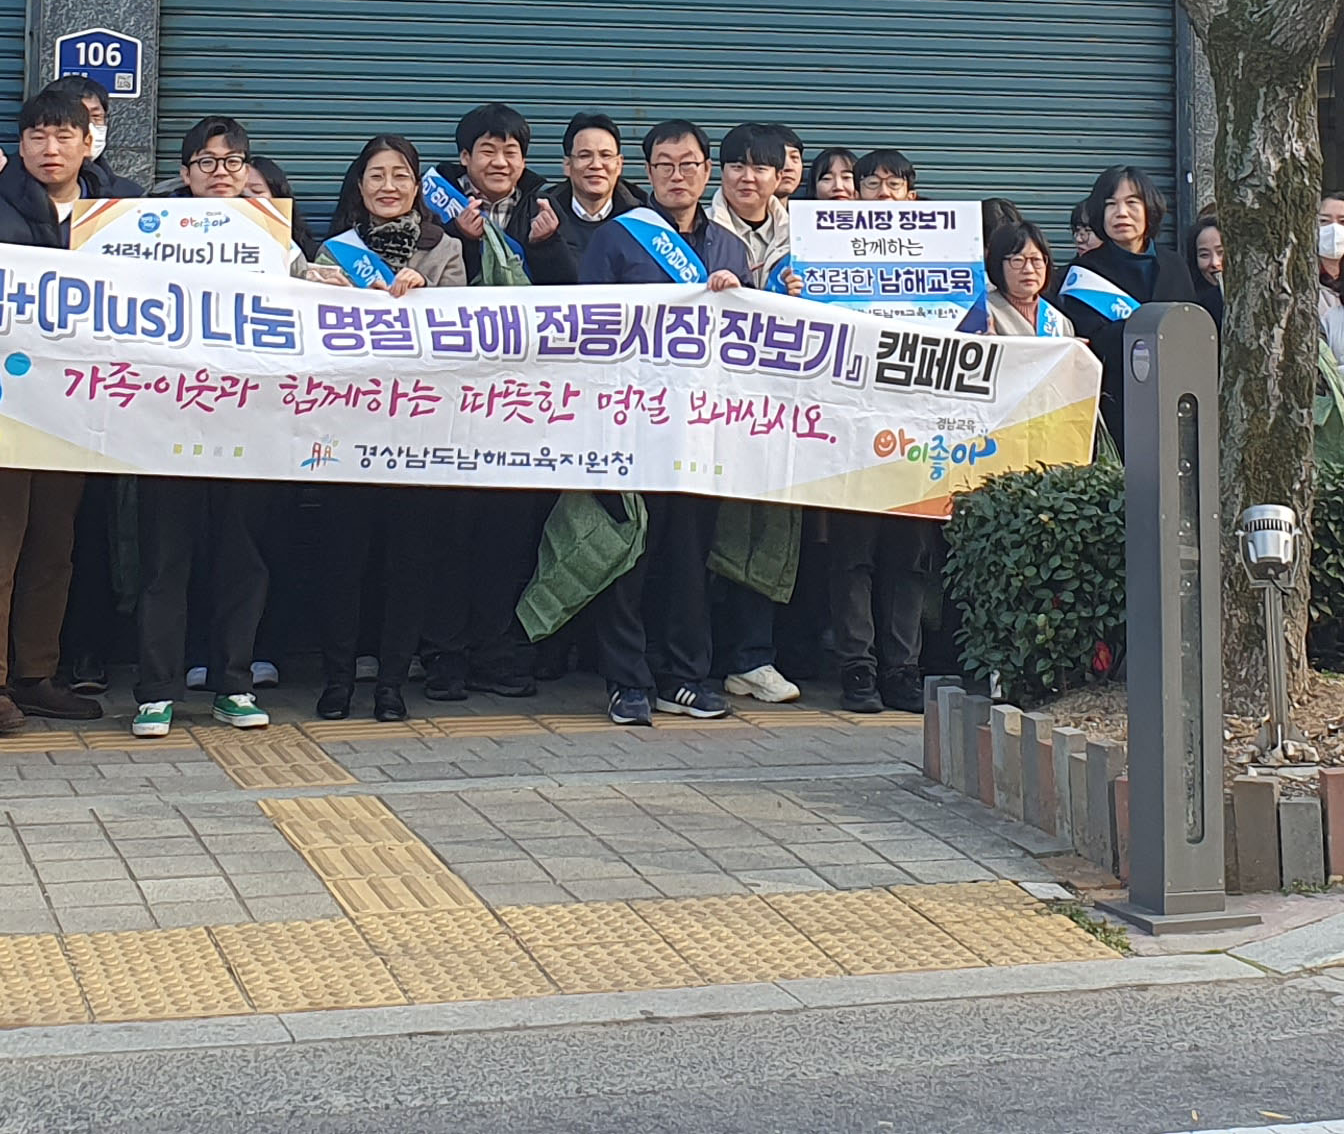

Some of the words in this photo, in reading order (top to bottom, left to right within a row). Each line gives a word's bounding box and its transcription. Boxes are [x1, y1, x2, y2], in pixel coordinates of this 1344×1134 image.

[75, 42, 122, 67] 106
[815, 210, 893, 231] 전통시장
[898, 210, 957, 230] 장보기
[220, 242, 260, 265] 나눔
[851, 237, 924, 257] 함께하는
[805, 268, 874, 295] 청렴한
[879, 267, 973, 295] 남해교육
[201, 290, 296, 350] 나눔
[317, 303, 409, 353] 명절
[425, 303, 520, 356] 남해
[535, 302, 710, 360] 전통시장
[875, 329, 1000, 395] 캠페인
[278, 374, 443, 420] 함께하는
[459, 379, 581, 424] 따뜻한
[597, 386, 670, 427] 명절
[689, 389, 838, 445] 보내십시오.
[935, 417, 976, 434] 경남교육
[354, 442, 635, 476] 경상남도남해교육지원청
[873, 427, 997, 481] 아이좋아
